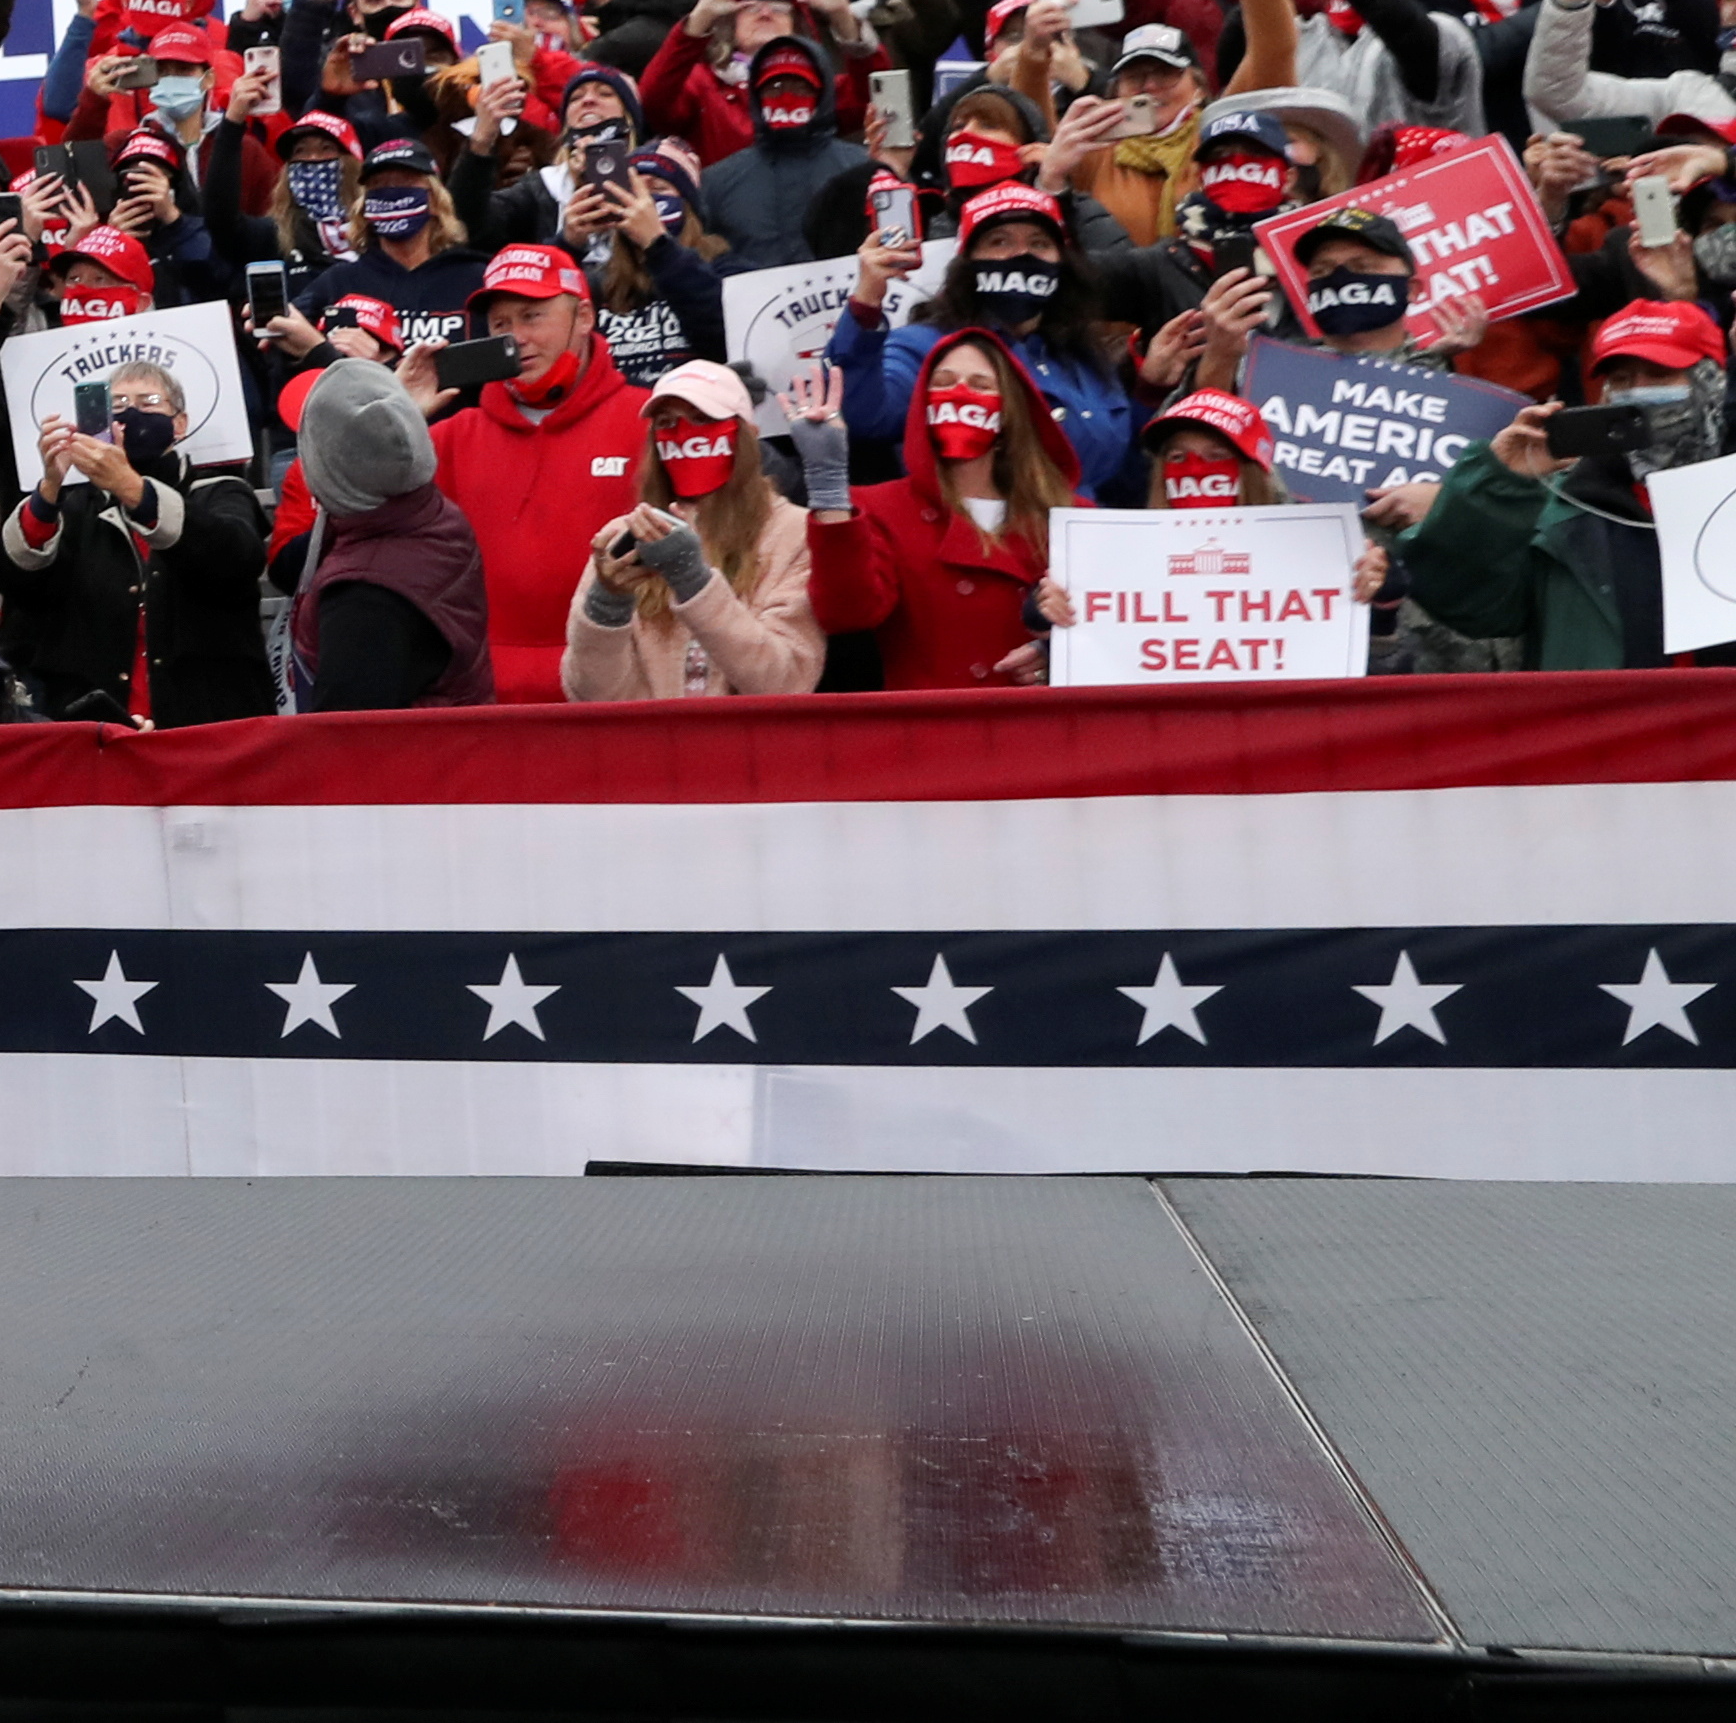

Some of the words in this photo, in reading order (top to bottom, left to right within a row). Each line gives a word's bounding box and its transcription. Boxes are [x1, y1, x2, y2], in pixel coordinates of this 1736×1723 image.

[1210, 114, 1261, 136] USA
[1406, 201, 1515, 265] THAT
[400, 315, 464, 337] UMP
[775, 288, 902, 329] TRUCKS
[62, 344, 178, 384] TRUCKERS
[1332, 378, 1448, 423] MAKE
[1258, 395, 1470, 468] AMERIC
[591, 456, 629, 477] CAT
[1272, 440, 1376, 485] REAT
[1084, 589, 1189, 623] FILL
[1205, 588, 1341, 622] THAT
[1139, 637, 1285, 672] SEAT!
